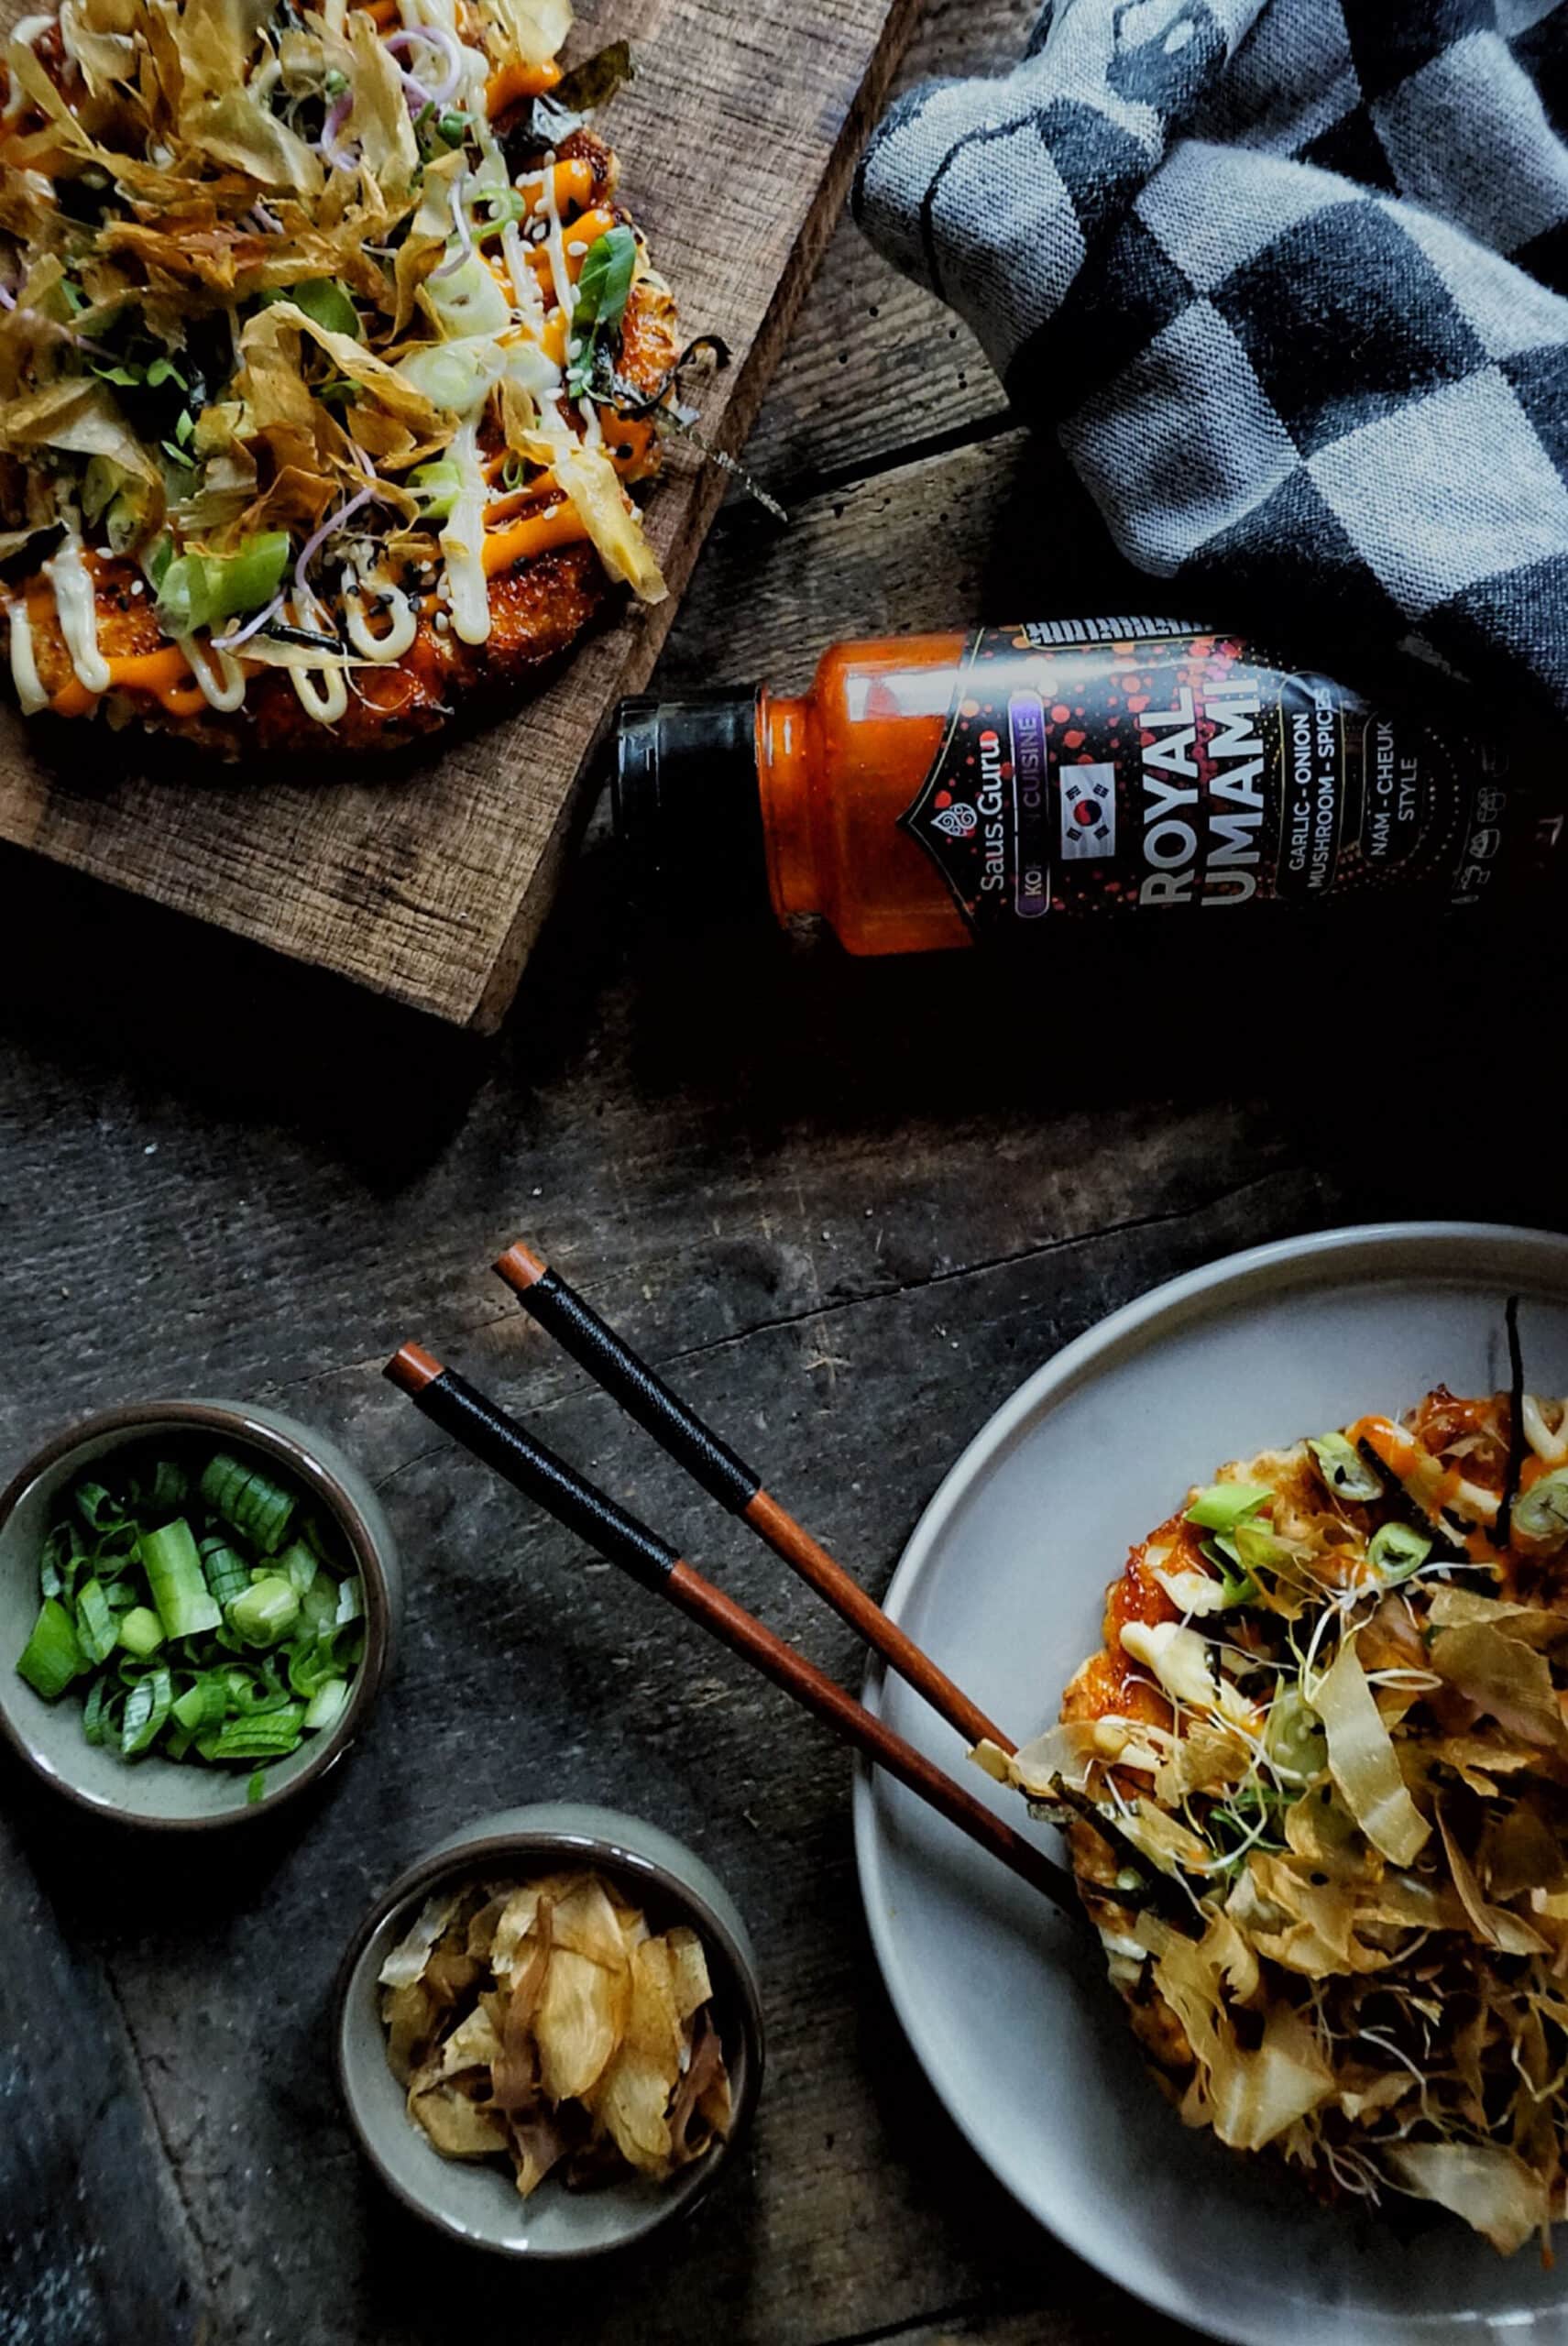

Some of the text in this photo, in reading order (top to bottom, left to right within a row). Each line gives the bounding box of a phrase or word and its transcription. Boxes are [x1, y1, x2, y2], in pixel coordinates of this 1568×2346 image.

[1292, 713, 1312, 784] ONION
[1315, 686, 1336, 758] SPICES
[1376, 719, 1394, 795] CHEUK
[1019, 717, 1041, 807] CUISINE
[1139, 686, 1199, 905] ROYAL
[1201, 678, 1265, 906] UMAMI
[1398, 756, 1418, 821] STYLE
[977, 738, 1004, 891] Saus.Guru
[1288, 801, 1311, 871] GARLIC
[1307, 775, 1336, 888] MUSHROOM
[1370, 812, 1391, 857] NAM
